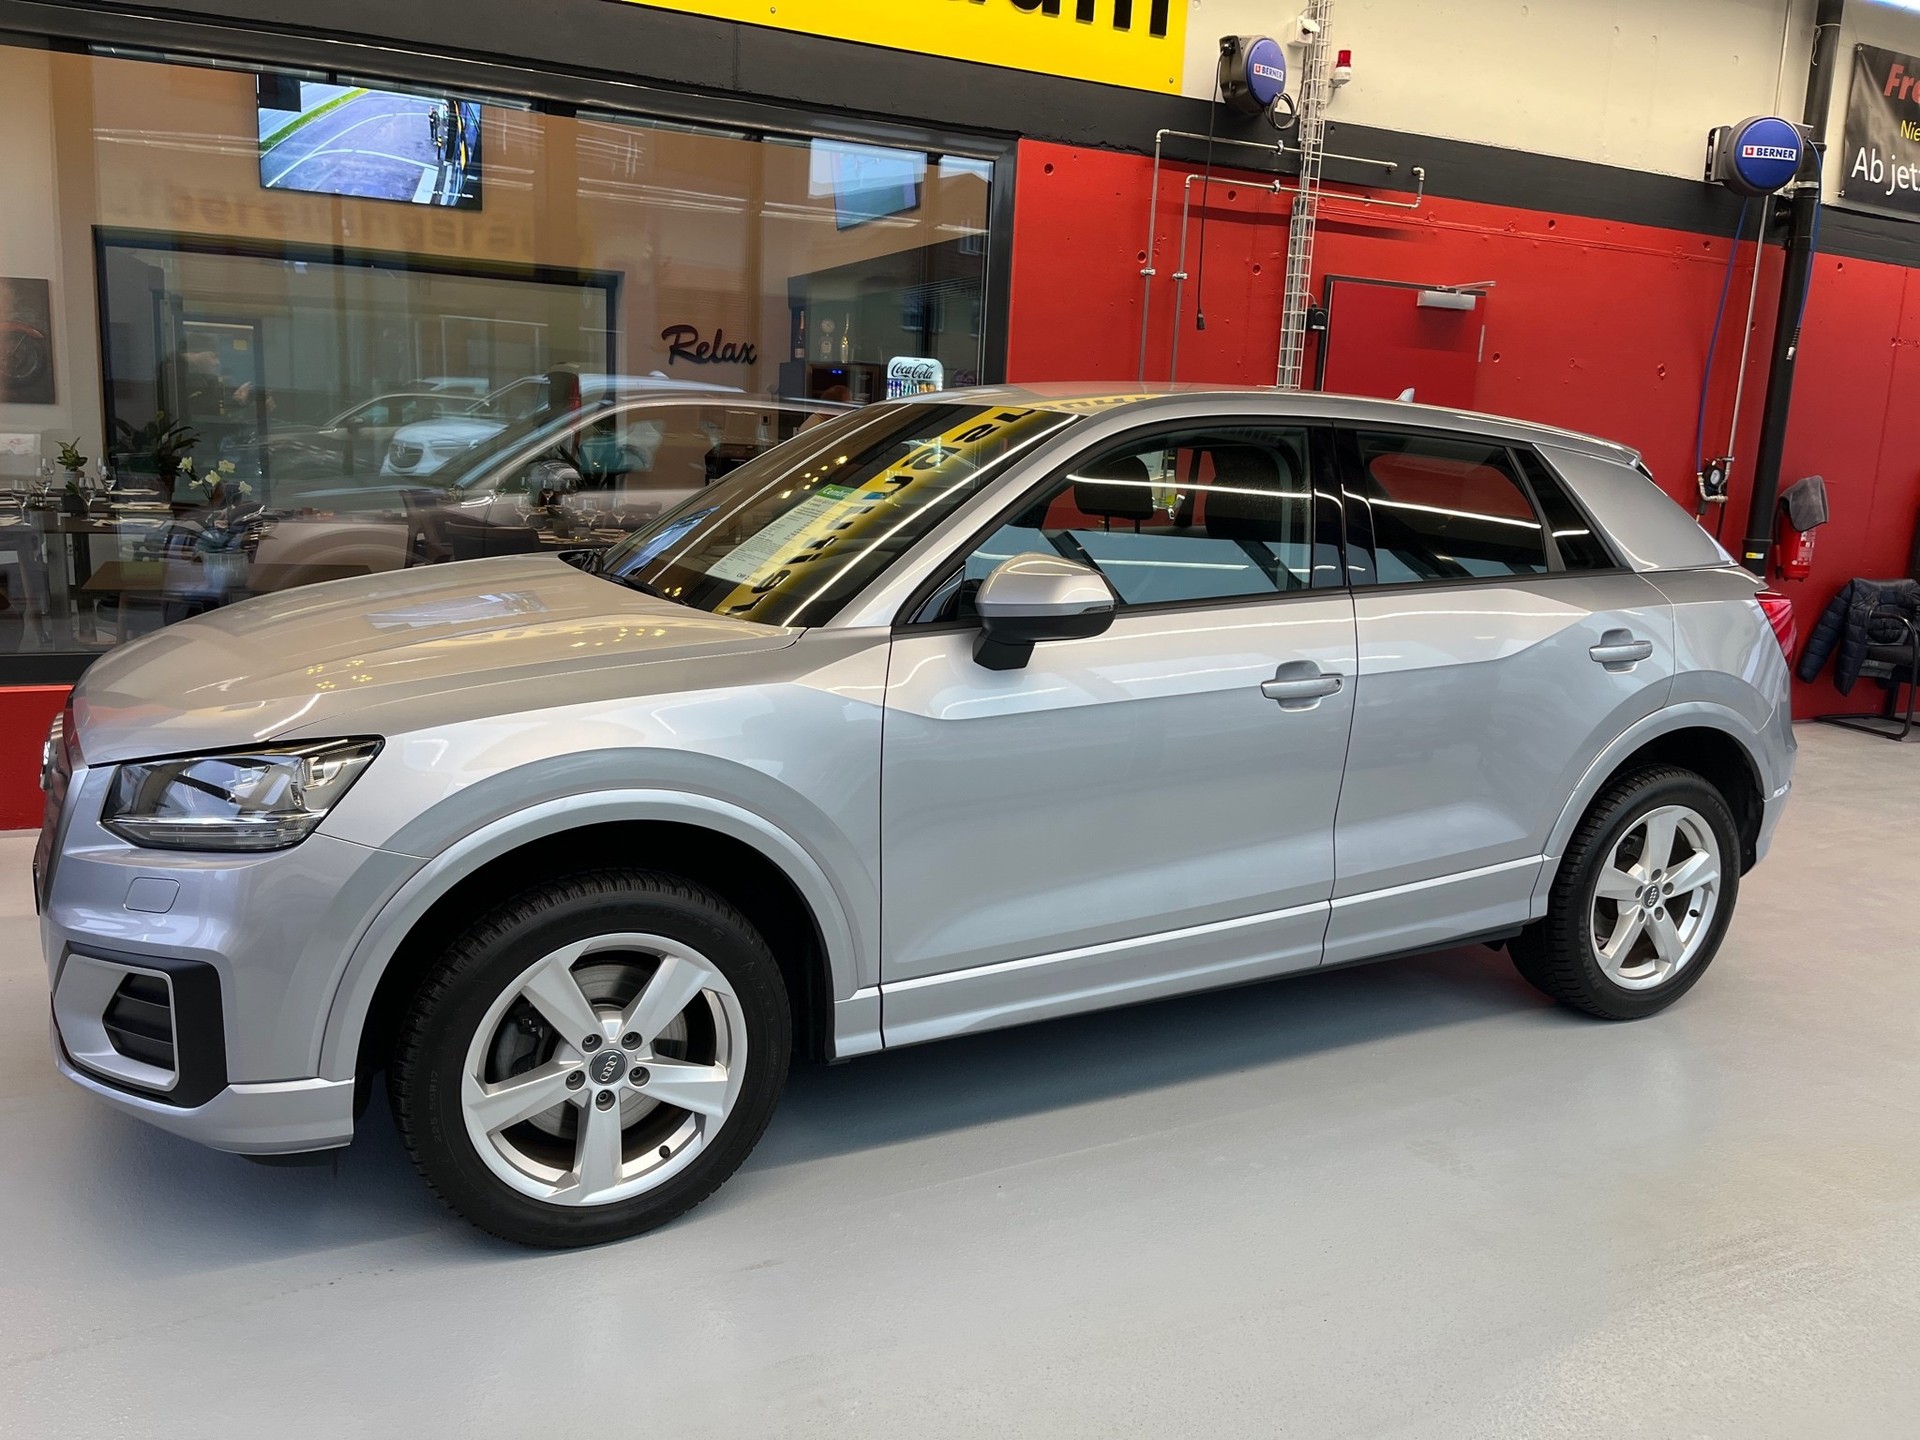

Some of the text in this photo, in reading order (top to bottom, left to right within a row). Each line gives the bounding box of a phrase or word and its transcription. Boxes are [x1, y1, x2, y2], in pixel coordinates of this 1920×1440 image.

[1261, 66, 1282, 79] BERNER
[1756, 146, 1794, 160] BERNER
[1851, 147, 1920, 196] Ab jet
[661, 324, 757, 365] Relax
[891, 362, 935, 379] Coca-Cola
